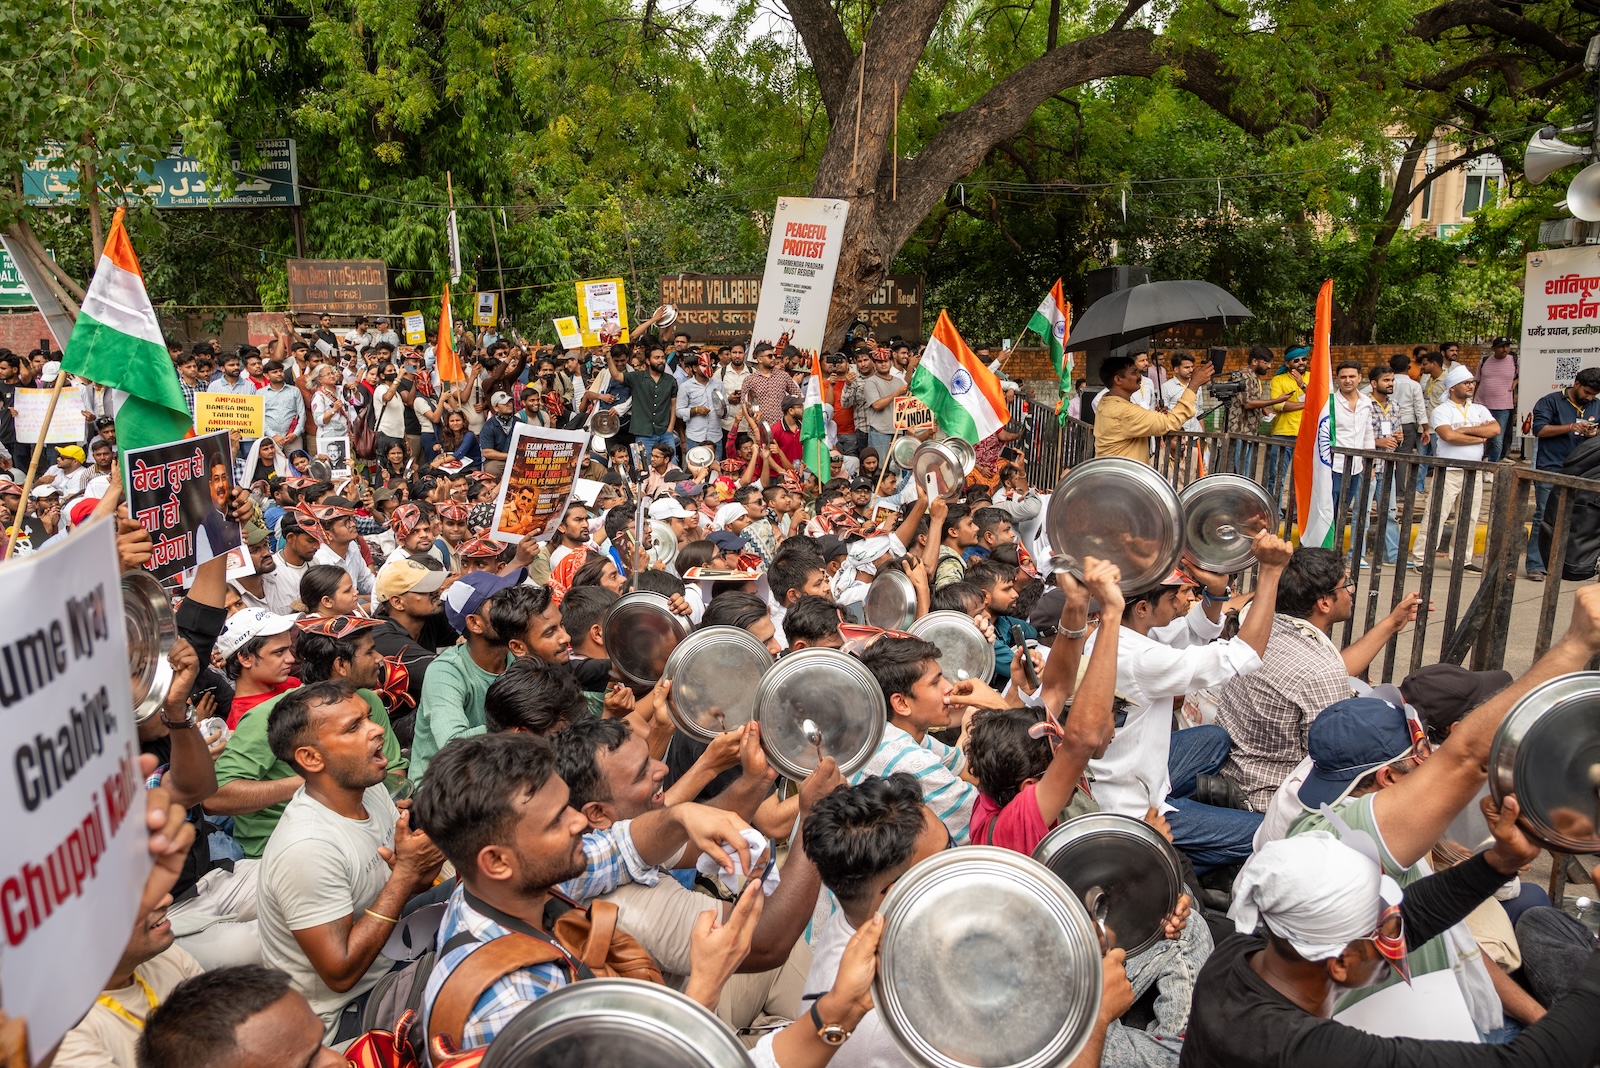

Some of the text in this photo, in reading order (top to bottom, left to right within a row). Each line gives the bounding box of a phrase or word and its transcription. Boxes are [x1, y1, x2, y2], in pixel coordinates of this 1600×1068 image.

[785, 222, 827, 240] PEACEFUL
[782, 238, 826, 259] PROTEST
[777, 259, 824, 270] DHARMENDRA PRADHAN
[784, 266, 797, 275] MUST
[0, 270, 14, 282] AL
[663, 280, 703, 304] SARDAR
[866, 280, 895, 304] UST
[677, 310, 720, 324] सरदार
[871, 309, 899, 327] ट्रस्ट
[1547, 298, 1600, 320] प्रदर्शन
[907, 409, 932, 427] INDIA
[132, 447, 204, 493] बेटा तुम से
[137, 493, 180, 532] ना हो
[66, 582, 110, 661] Nyay
[235, 630, 251, 645] CG17
[0, 791, 106, 947] Chuppi
